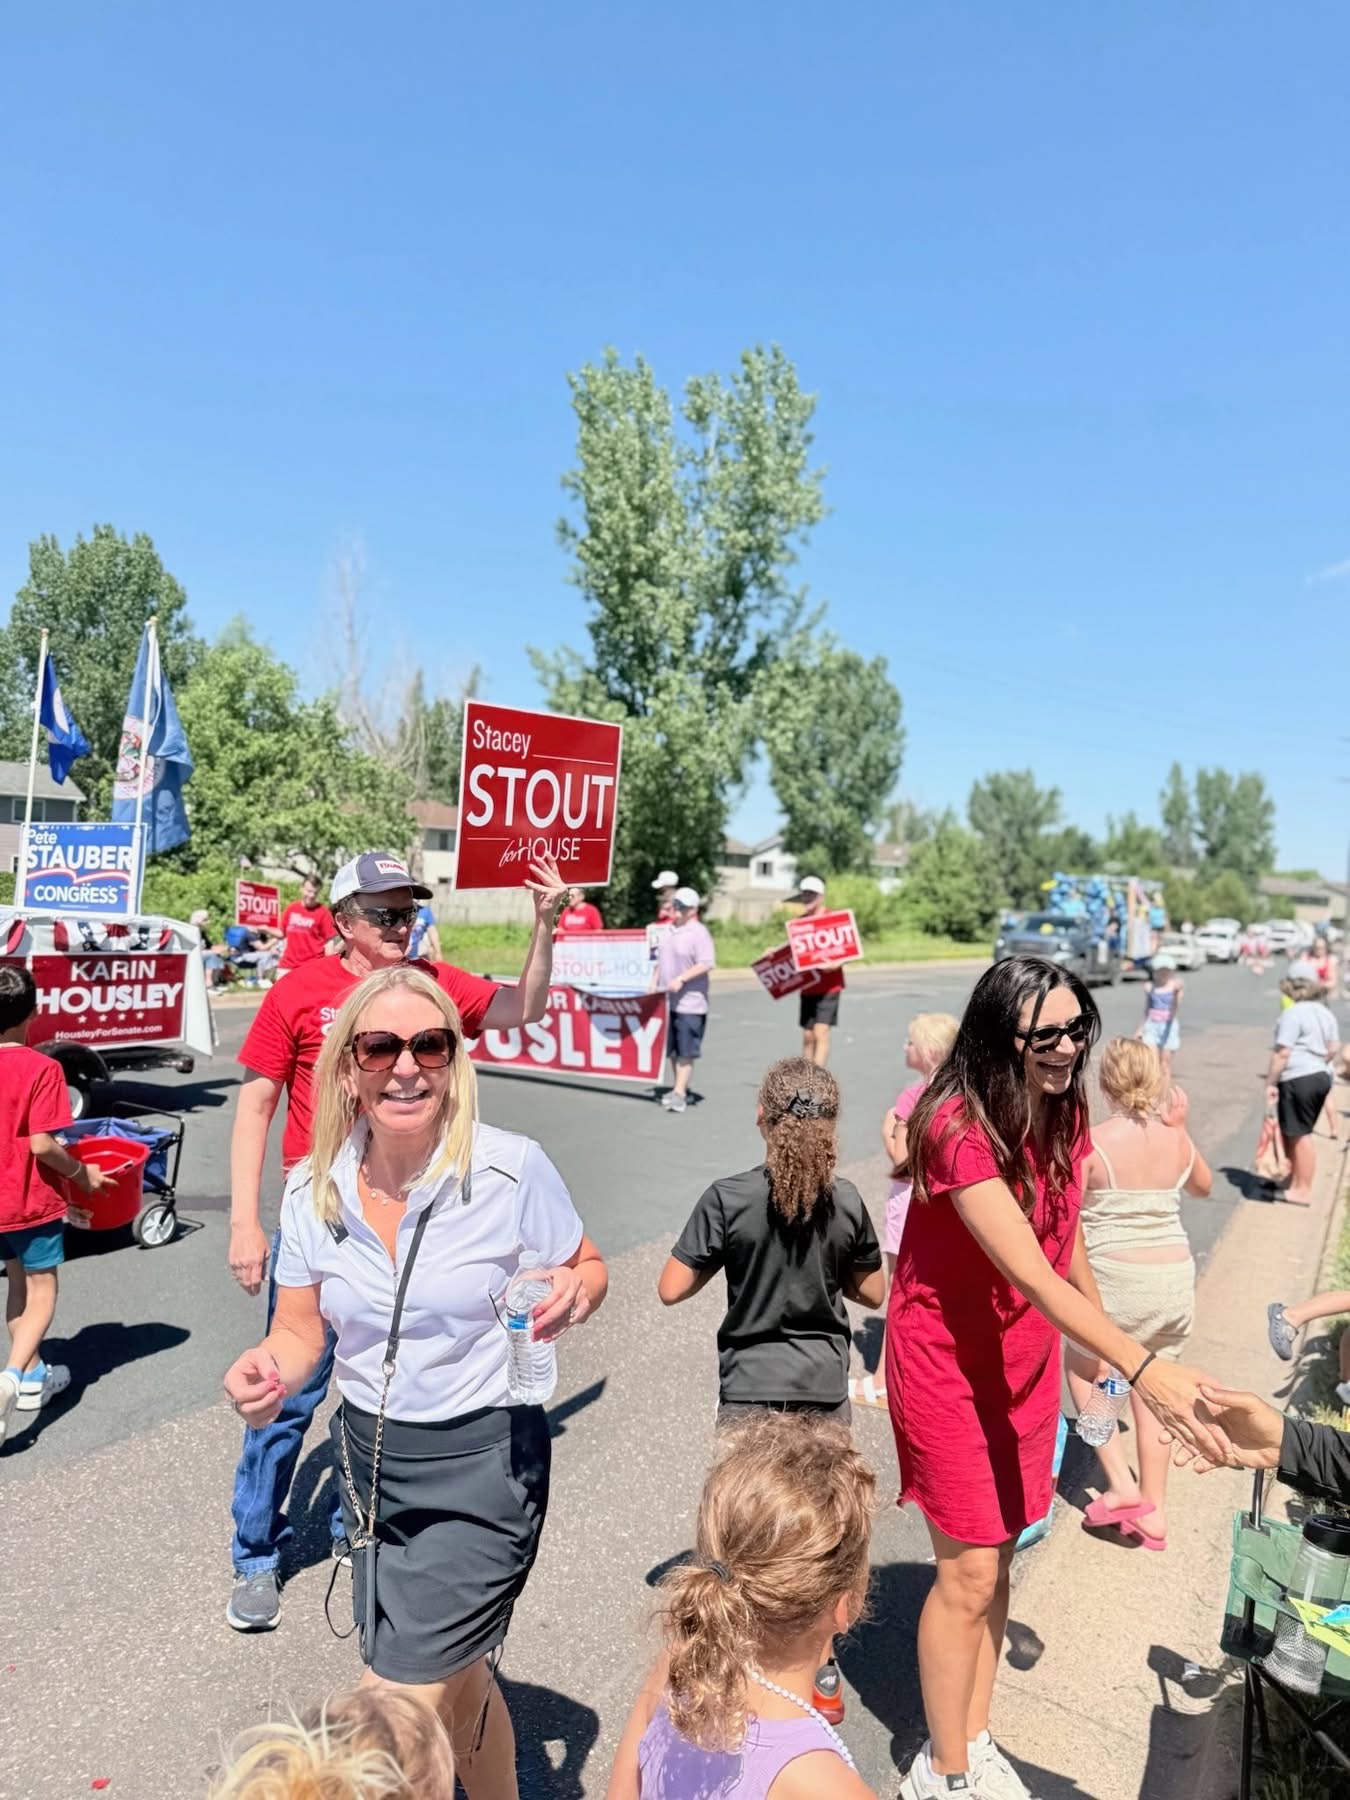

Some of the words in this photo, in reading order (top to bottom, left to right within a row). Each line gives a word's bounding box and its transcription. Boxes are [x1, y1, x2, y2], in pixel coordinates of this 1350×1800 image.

[473, 719, 531, 760] Stacey
[466, 763, 614, 830] STOUT
[28, 829, 58, 845] Pete
[27, 844, 133, 870] STAUBER
[517, 837, 581, 861] HOUSE
[33, 885, 118, 904] CONGRESS
[239, 893, 279, 916] STOUT
[793, 925, 855, 955] STOUT
[70, 960, 157, 982] KARIN
[36, 982, 184, 1015] HOUSLEY
[575, 991, 643, 1014] KARIN
[55, 1024, 163, 1042] HousleyForSenate.com
